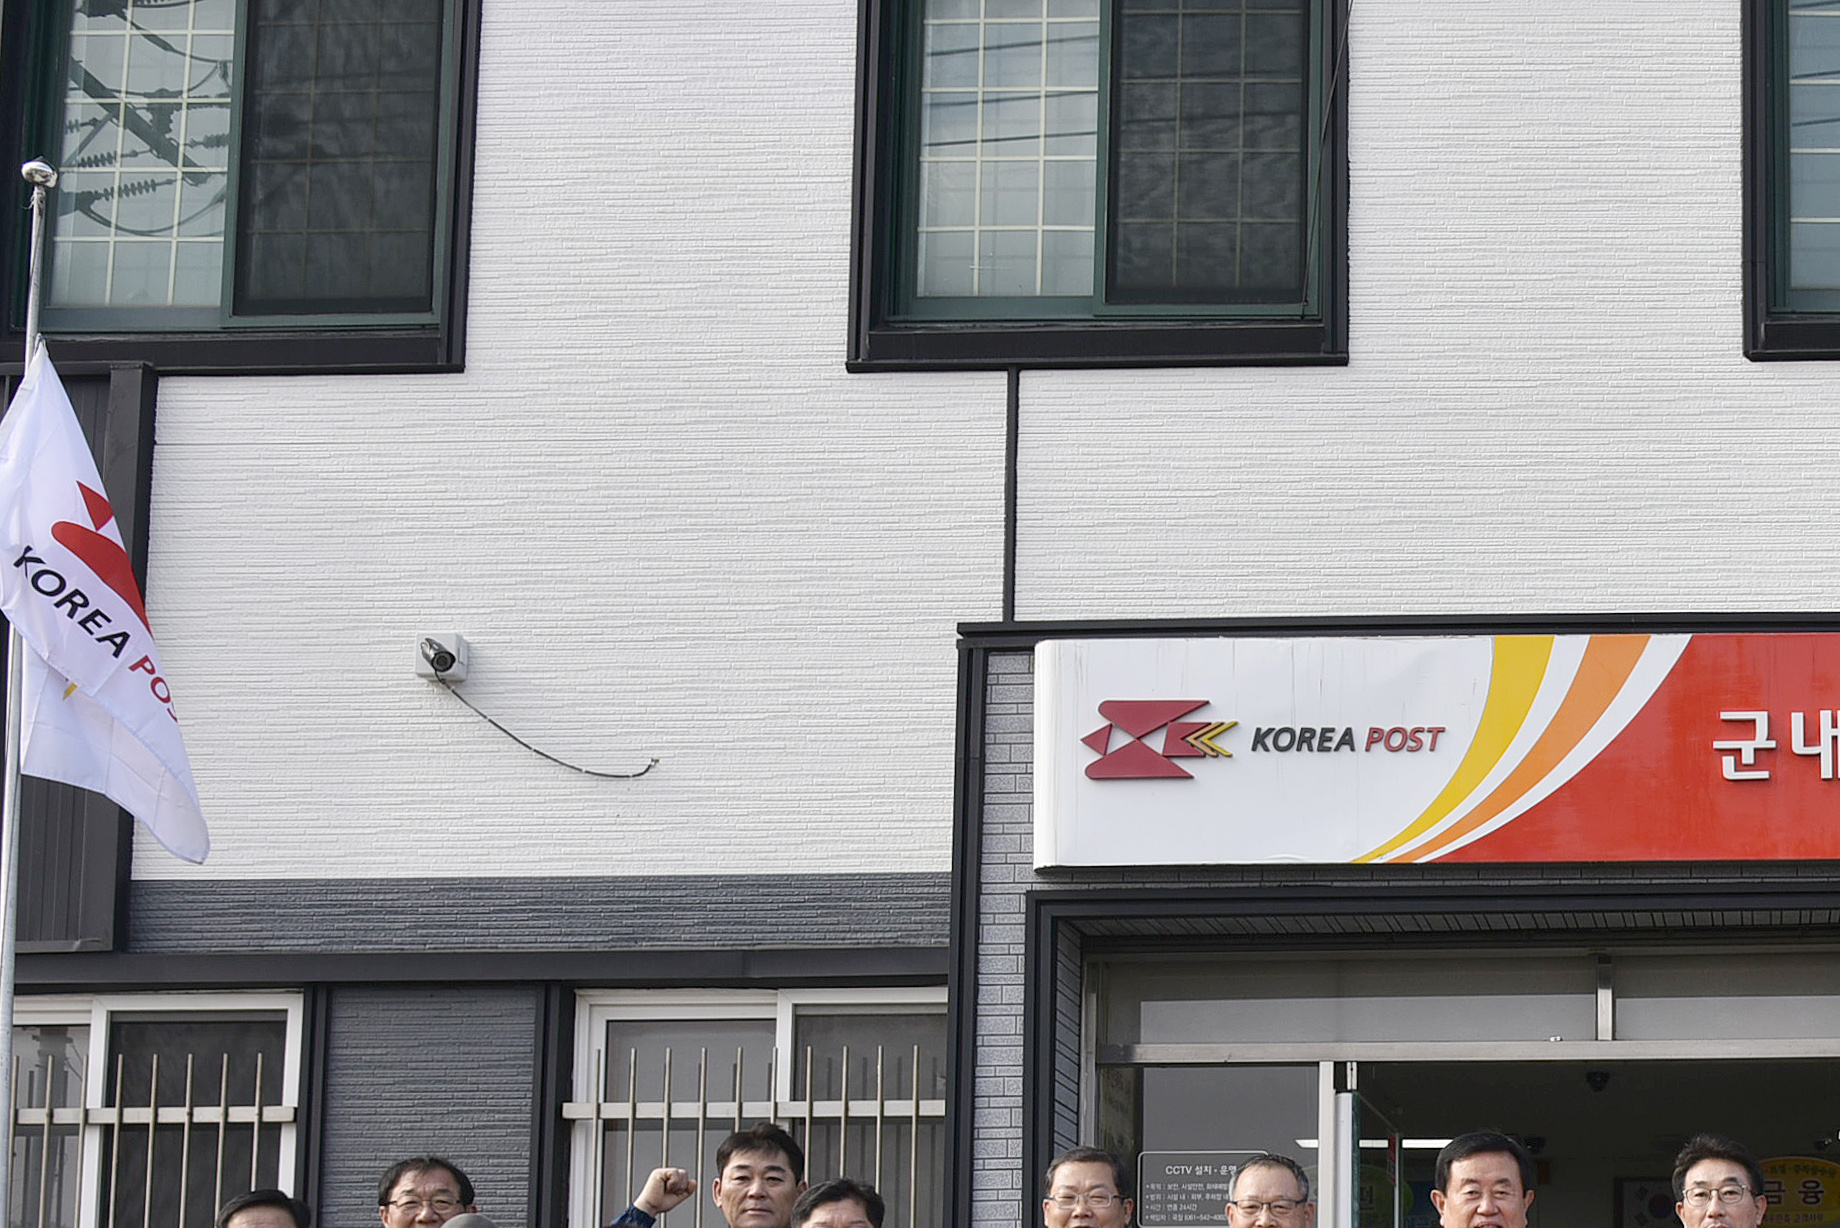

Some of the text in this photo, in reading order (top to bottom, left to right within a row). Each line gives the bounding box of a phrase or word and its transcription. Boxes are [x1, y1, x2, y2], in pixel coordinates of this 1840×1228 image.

[13, 545, 131, 658] KOREA
[1251, 727, 1446, 752] KOREA POST
[1165, 1165, 1192, 1175] CCTV
